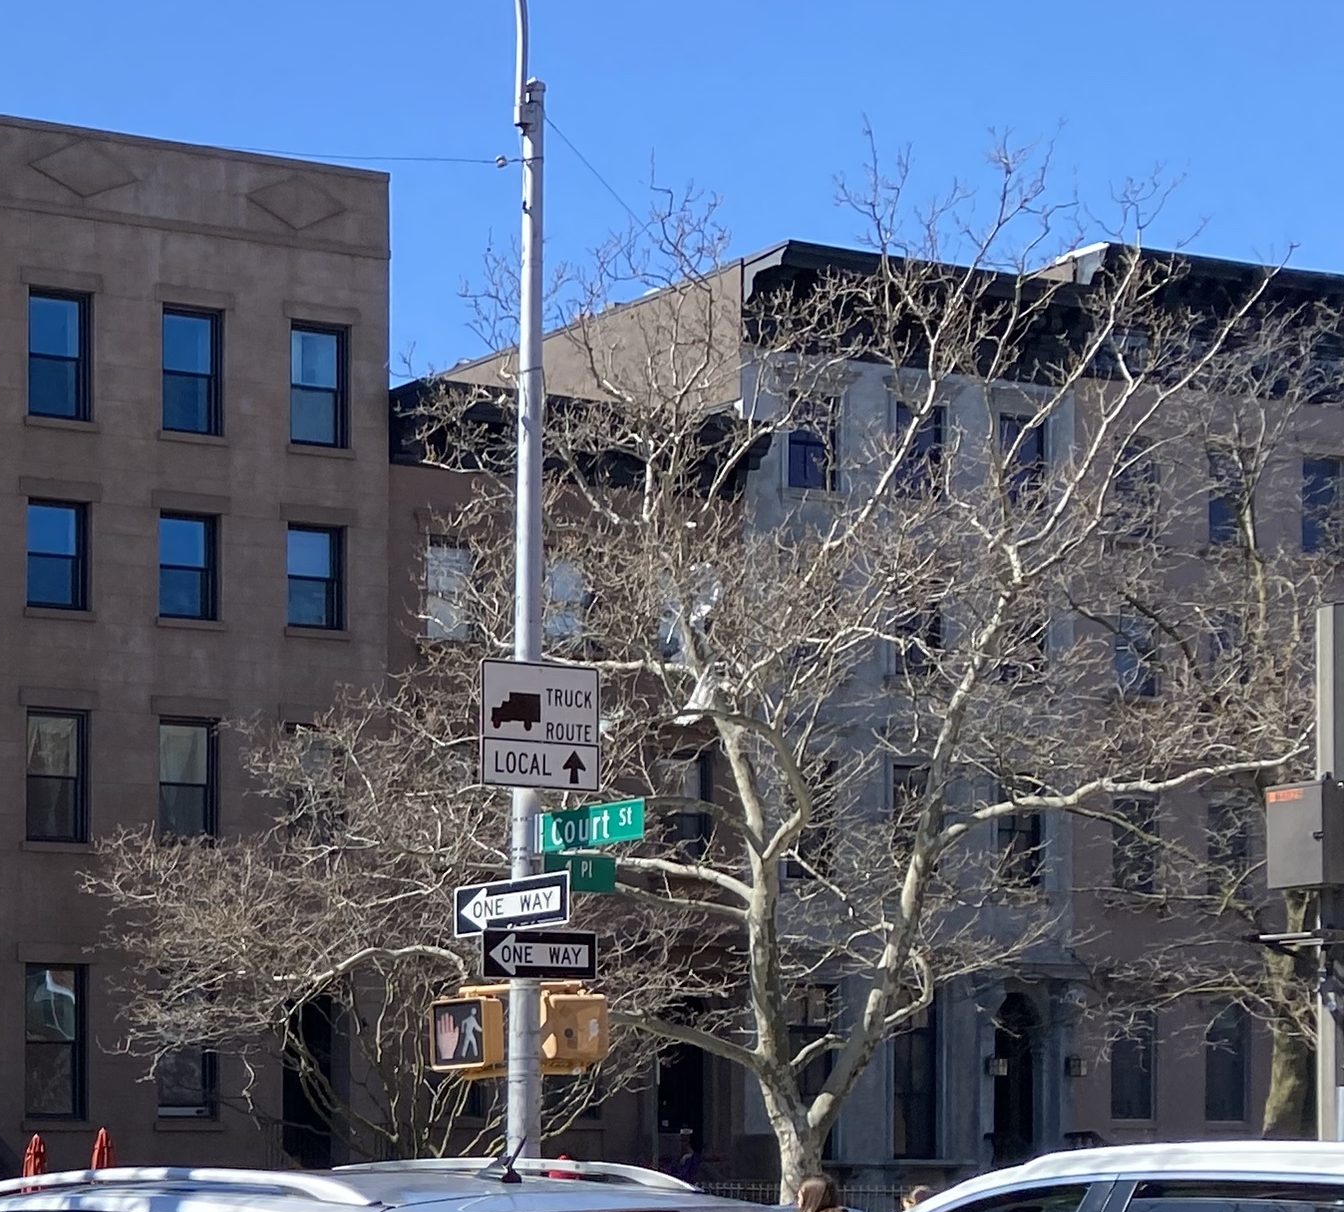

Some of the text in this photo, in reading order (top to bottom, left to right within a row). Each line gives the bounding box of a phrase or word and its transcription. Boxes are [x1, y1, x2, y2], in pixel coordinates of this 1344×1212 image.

[546, 688, 592, 709] TRUCK
[546, 722, 592, 742] ROUTE
[495, 750, 552, 776] LOCAL
[551, 806, 633, 846] Court St
[581, 860, 593, 879] Pl
[473, 890, 554, 919] ONE WAY
[501, 945, 582, 965] ONE WAY
